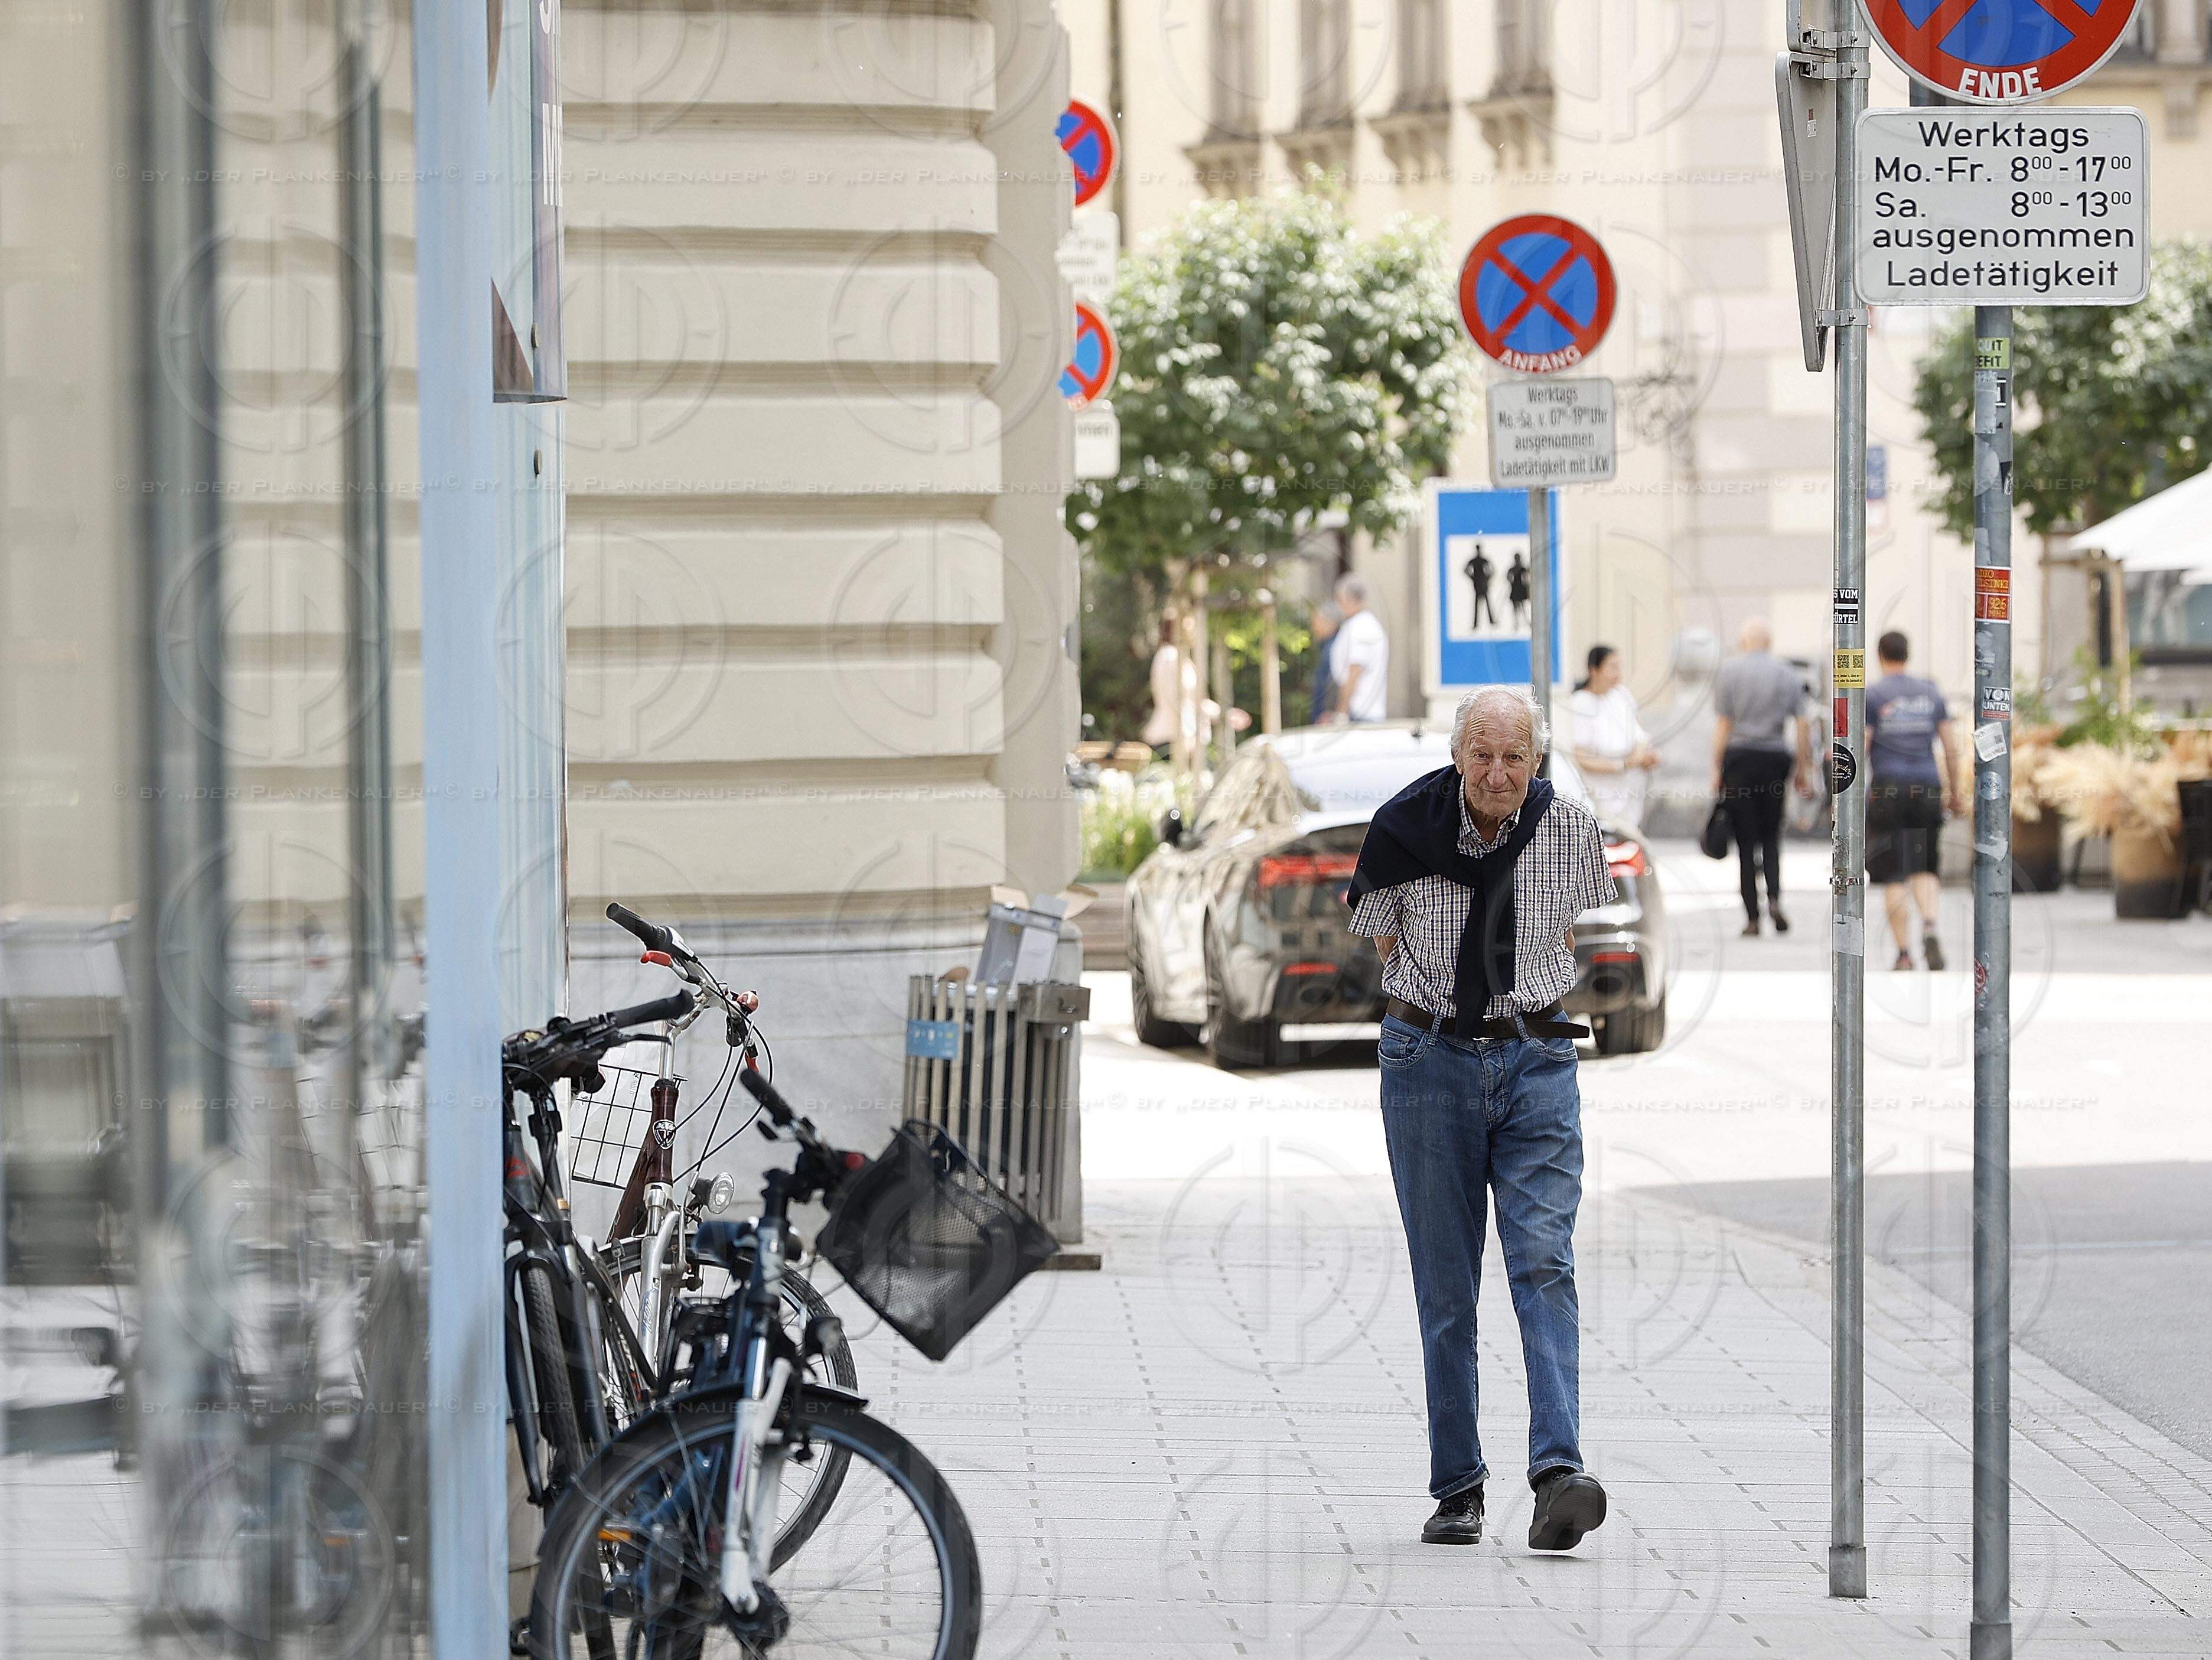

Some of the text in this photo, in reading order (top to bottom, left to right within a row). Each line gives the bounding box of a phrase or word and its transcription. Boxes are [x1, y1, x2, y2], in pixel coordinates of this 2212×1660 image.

[1958, 67, 2042, 99] ENDE
[1918, 121, 2090, 154] Werktags
[1875, 192, 1926, 218] Sa.
[1872, 227, 2134, 255] ausgenommen
[1888, 261, 2119, 293] Ladetätigkeit
[1529, 386, 1579, 406] Werktags
[1516, 432, 1595, 455] ausgenommen
[1501, 454, 1610, 480] Ladetätigkeit mit LKW
[1839, 589, 1858, 599] VOM
